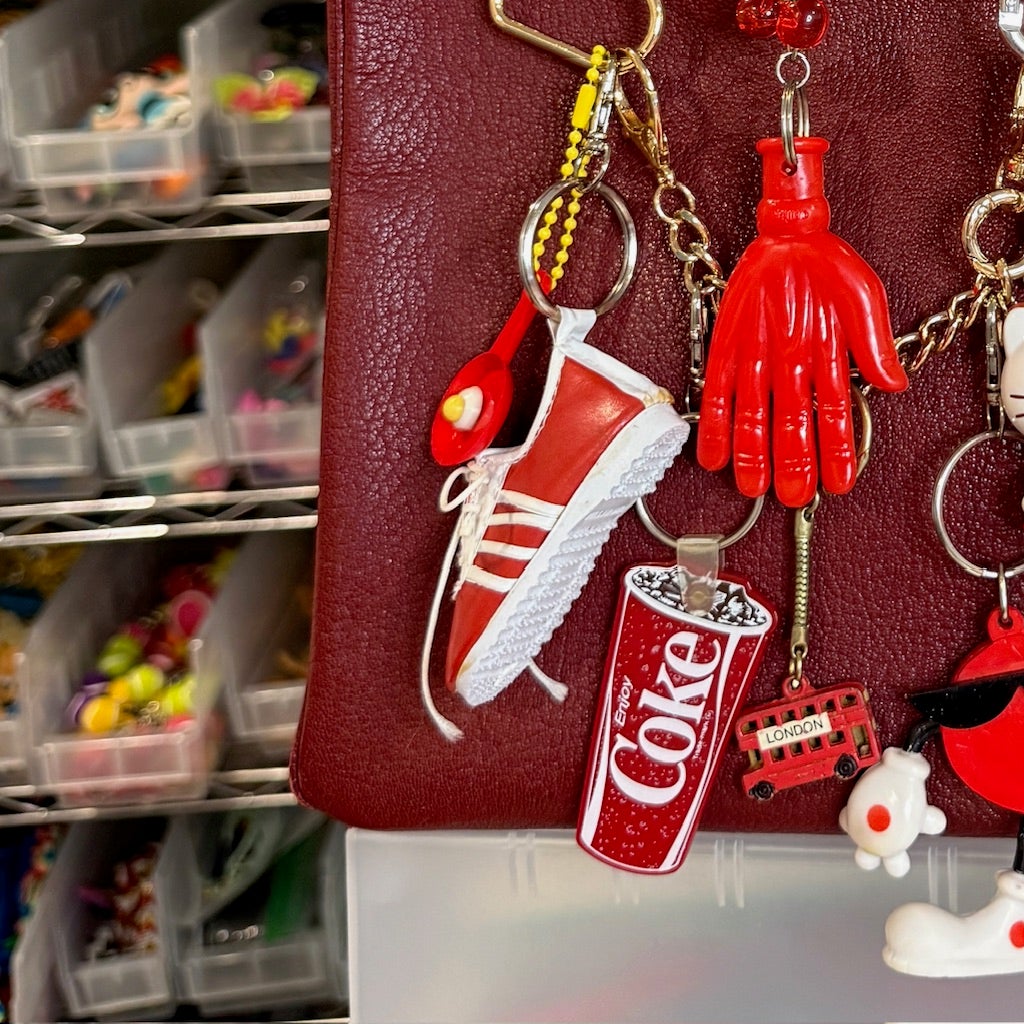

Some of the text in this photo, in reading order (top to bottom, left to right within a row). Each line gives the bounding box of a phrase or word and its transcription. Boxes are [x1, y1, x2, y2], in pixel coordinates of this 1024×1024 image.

[610, 631, 722, 806] Coke
[614, 675, 633, 726] Enjoy
[766, 719, 824, 744] LONDON
